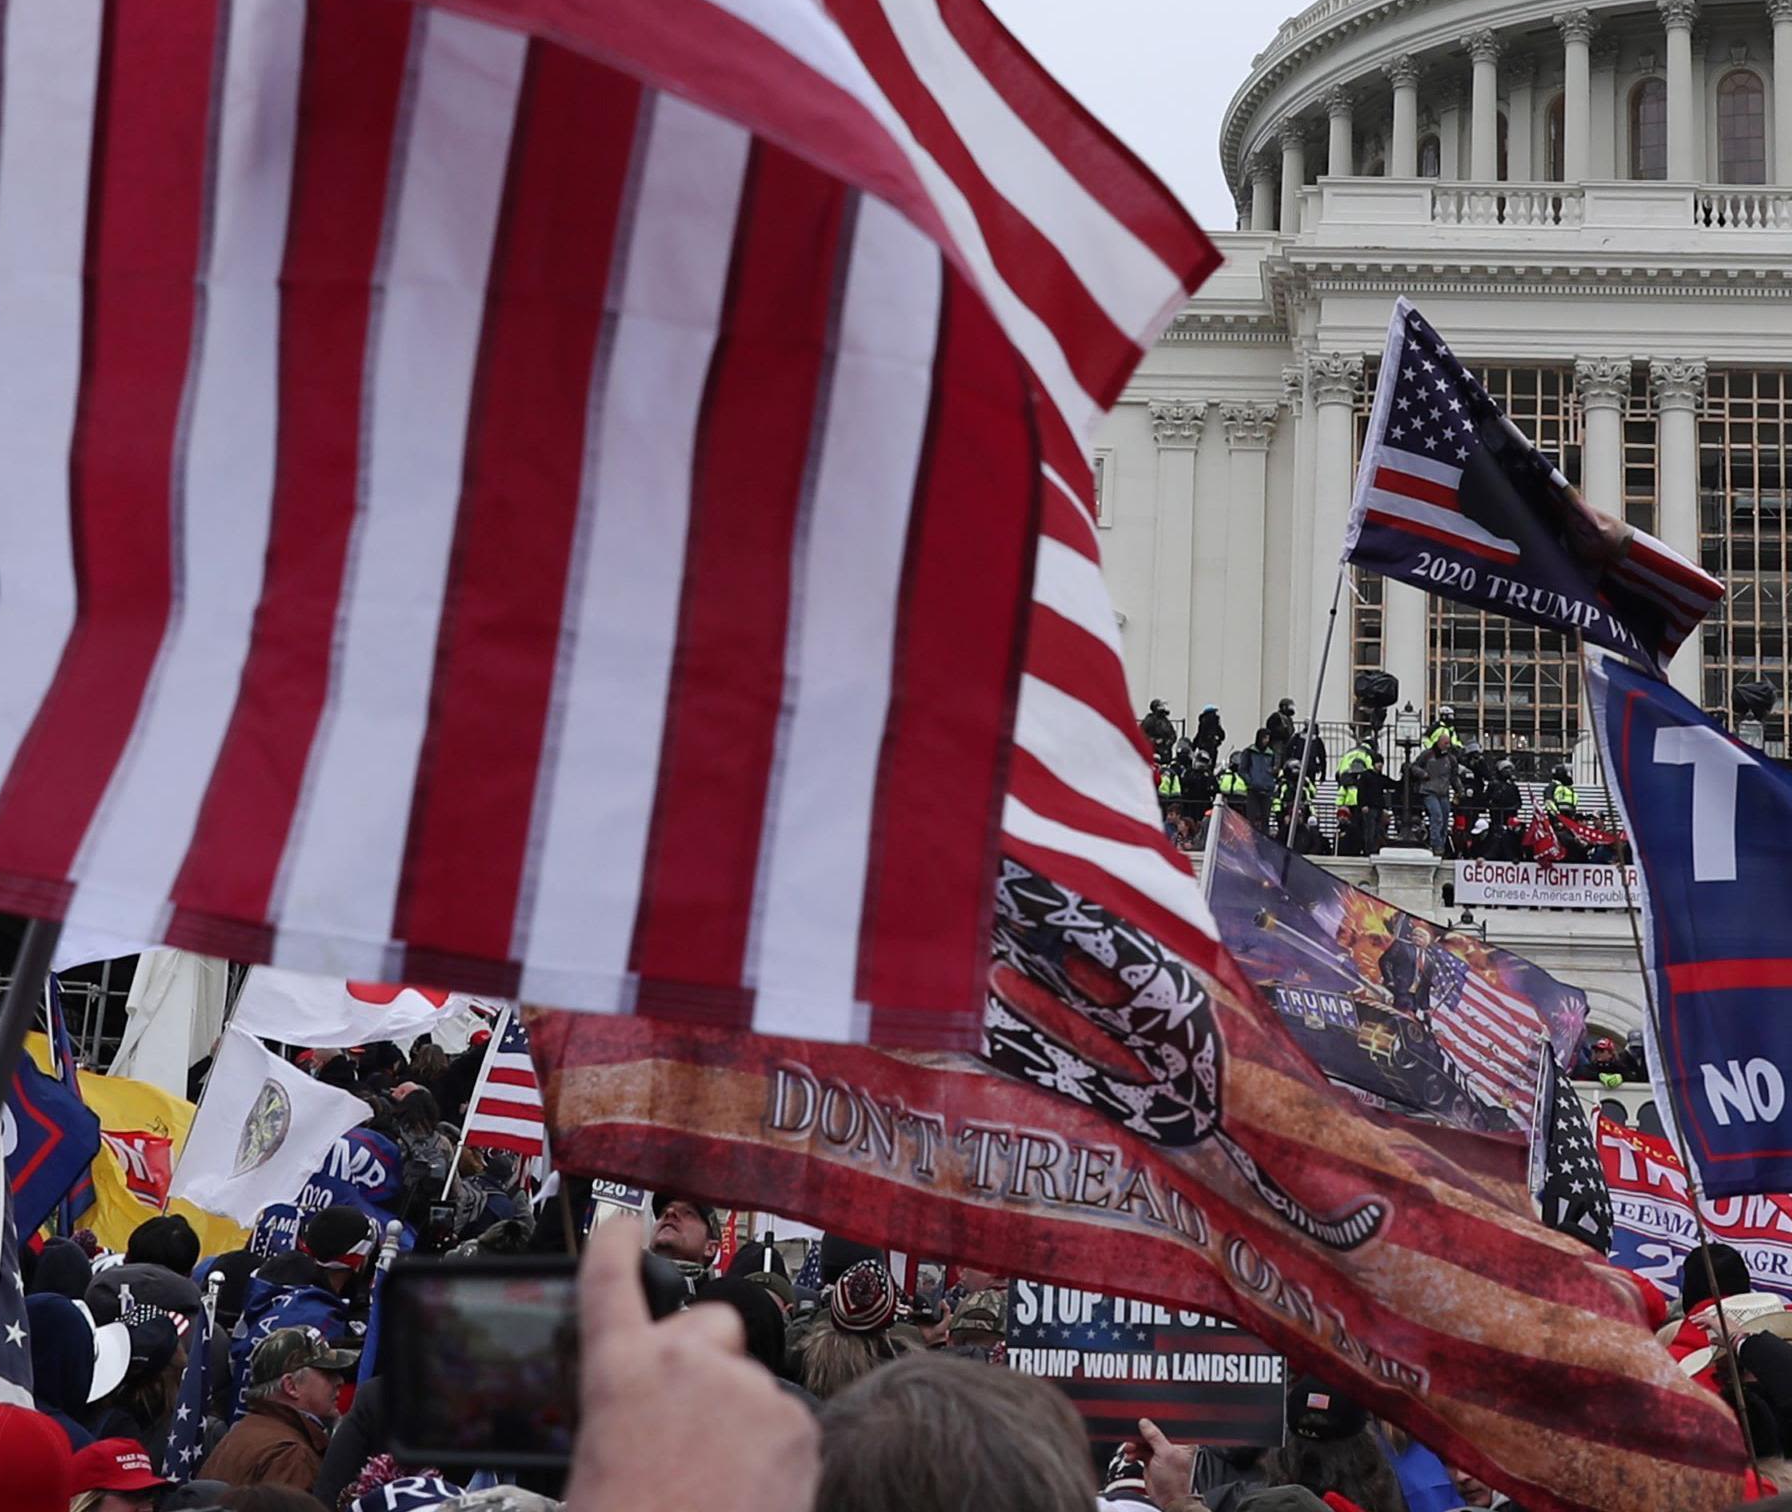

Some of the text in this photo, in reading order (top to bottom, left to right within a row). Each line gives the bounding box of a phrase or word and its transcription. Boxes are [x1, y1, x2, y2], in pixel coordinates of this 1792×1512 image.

[1411, 551, 1477, 592] 2020
[1486, 574, 1601, 629] TRUMP
[1463, 864, 1529, 885] GEORGIA
[1536, 867, 1579, 886] FIGHT
[1583, 869, 1614, 887] FOR
[1483, 886, 1582, 902] Chinese-American
[1275, 988, 1354, 1016] TRUMP
[1701, 1058, 1786, 1126] NO
[768, 1065, 945, 1178] DON'T
[961, 1124, 1210, 1248] TREAD
[591, 1178, 627, 1197] 020
[1016, 1279, 1104, 1326] STOP
[1007, 1348, 1282, 1384] TRUMP WON IN A LANDSLIDE
